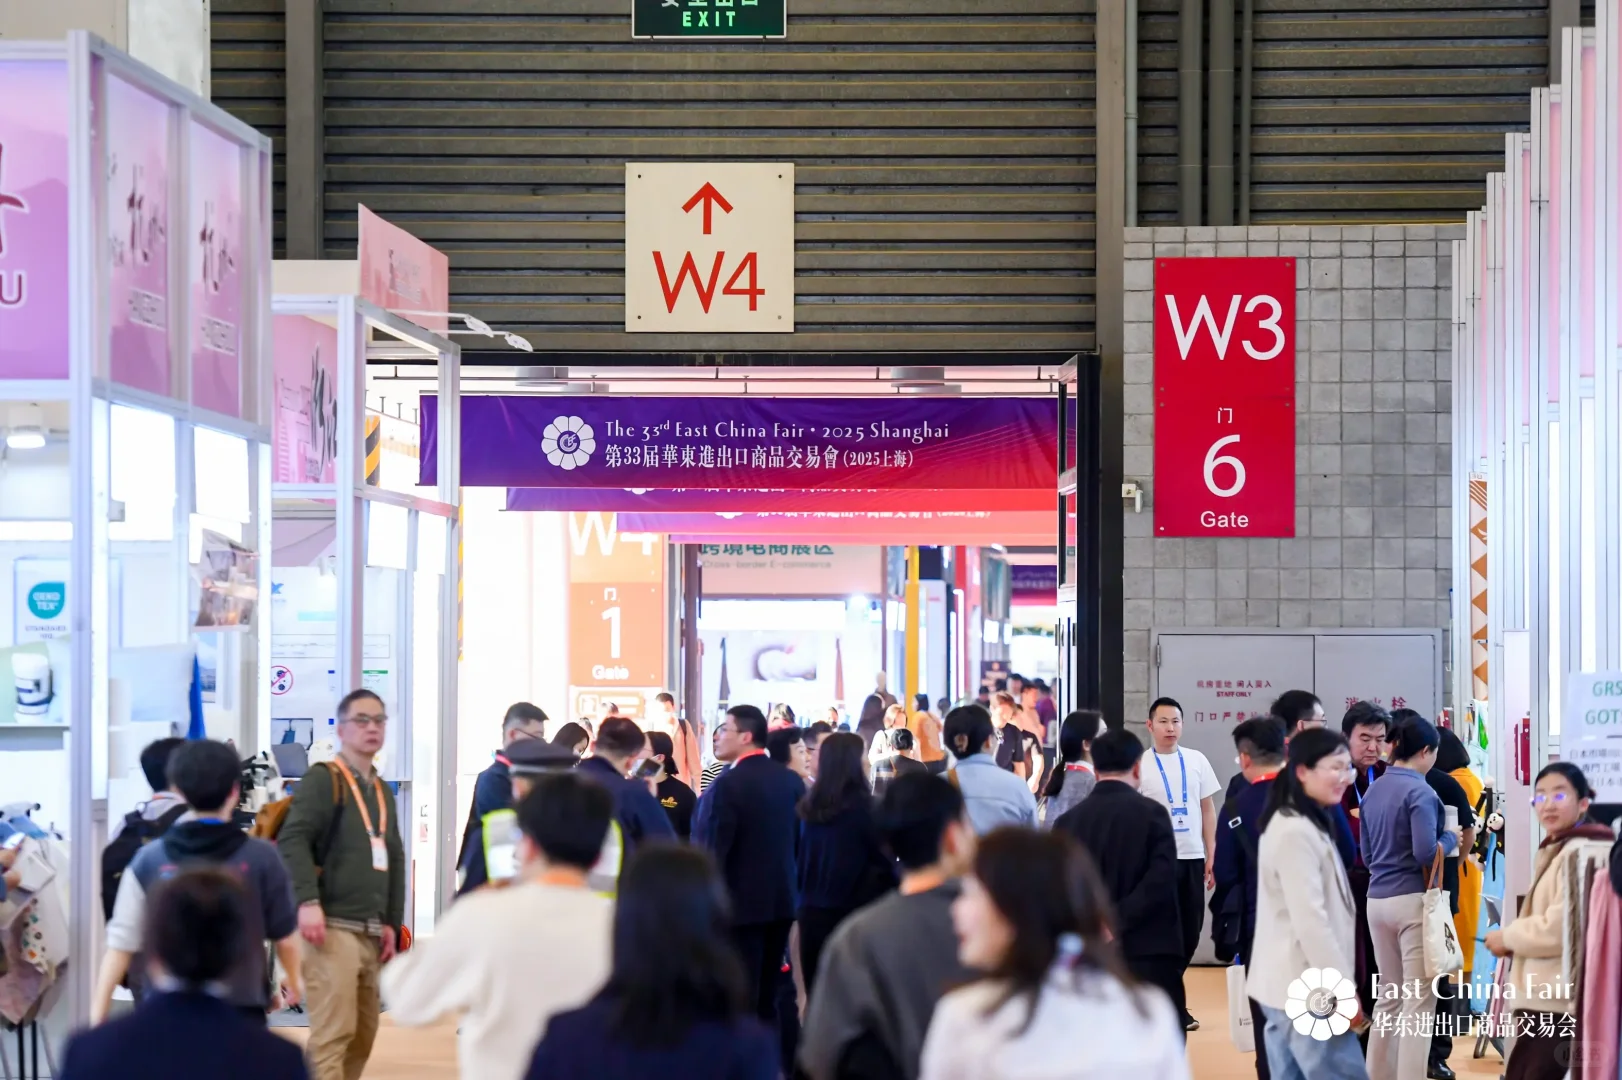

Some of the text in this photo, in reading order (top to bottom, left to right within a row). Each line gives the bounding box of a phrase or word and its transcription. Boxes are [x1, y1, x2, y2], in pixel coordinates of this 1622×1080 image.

[682, 11, 736, 27] EXIT
[652, 251, 765, 314] W4
[1164, 294, 1286, 361] W3
[1217, 408, 1233, 424] 门
[605, 420, 635, 437] The
[675, 421, 708, 437] East
[715, 420, 766, 438] China
[774, 422, 805, 438] Fair
[822, 426, 864, 442] 2025
[870, 420, 949, 444] Shanghai
[1203, 434, 1247, 498] 6
[1200, 511, 1249, 528] Gate
[601, 606, 621, 659] 1
[591, 665, 630, 680] Gate
[1585, 708, 1622, 725] GOT
